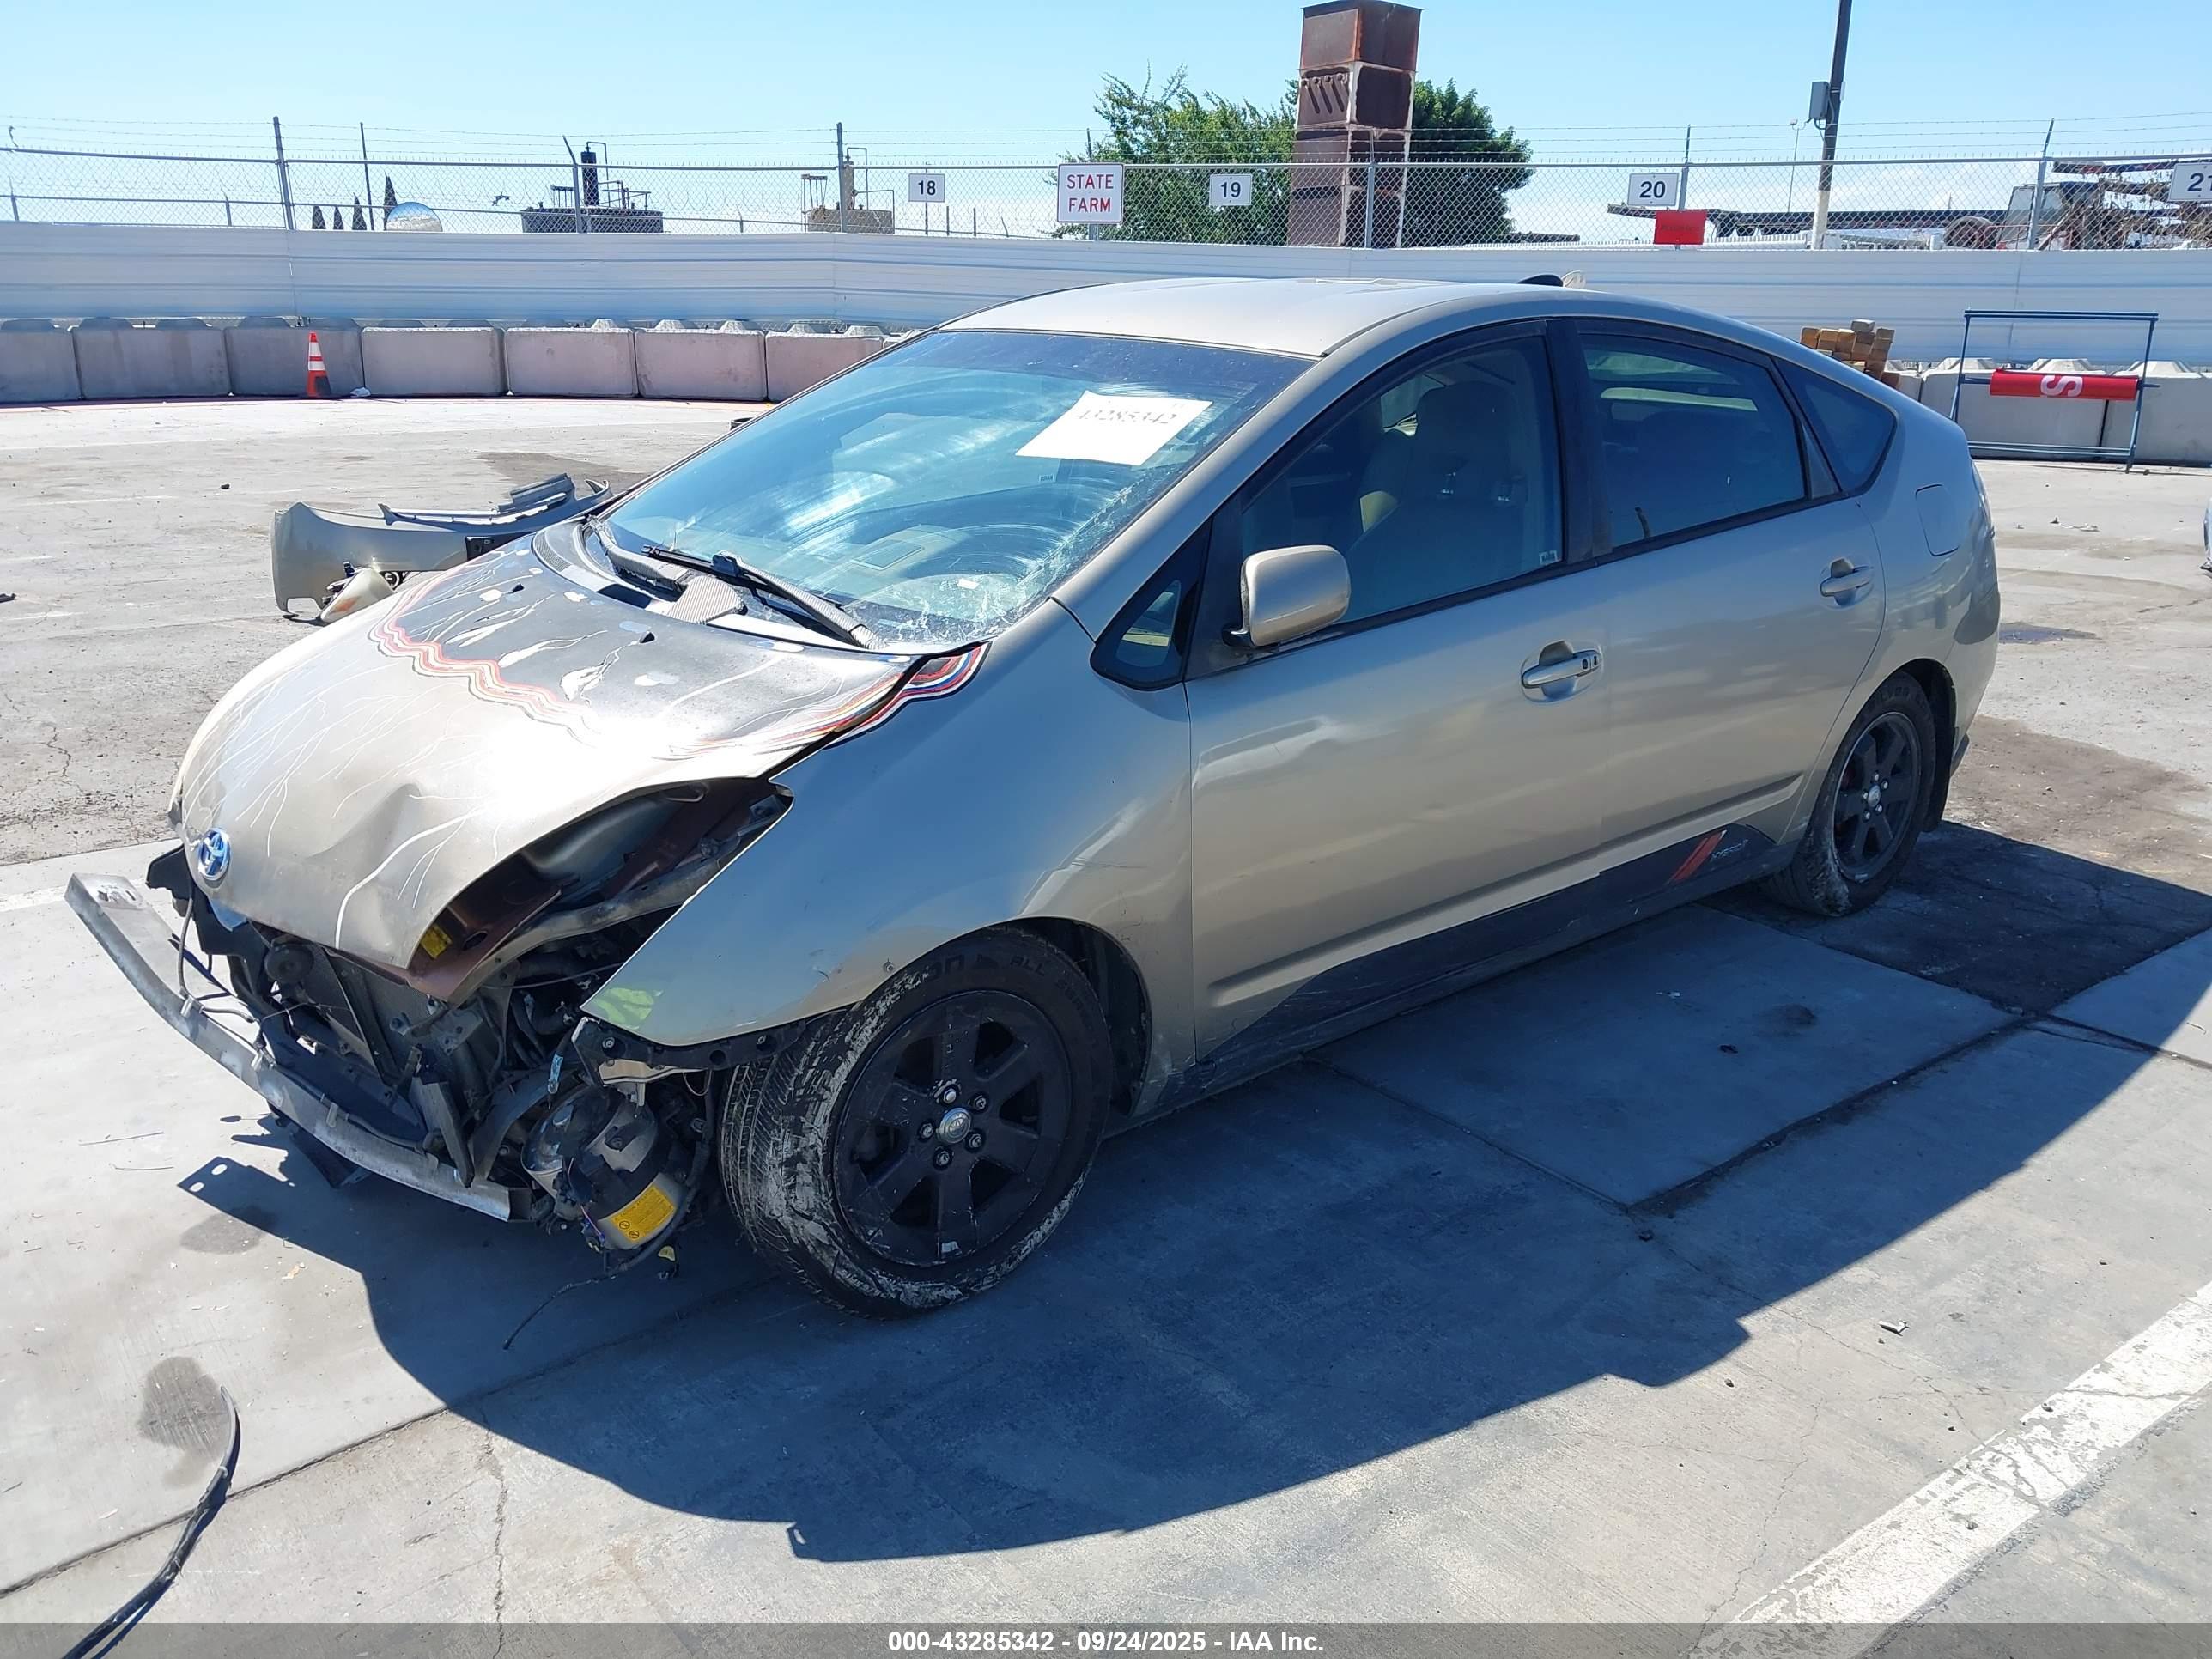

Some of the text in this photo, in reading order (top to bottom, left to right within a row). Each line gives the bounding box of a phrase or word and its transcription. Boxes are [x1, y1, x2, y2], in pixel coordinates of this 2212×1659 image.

[918, 180, 936, 196] 18
[1066, 174, 1114, 190] STATE
[1220, 181, 1242, 198] 19
[1639, 180, 1666, 198] 20
[1067, 198, 1112, 213] FARM
